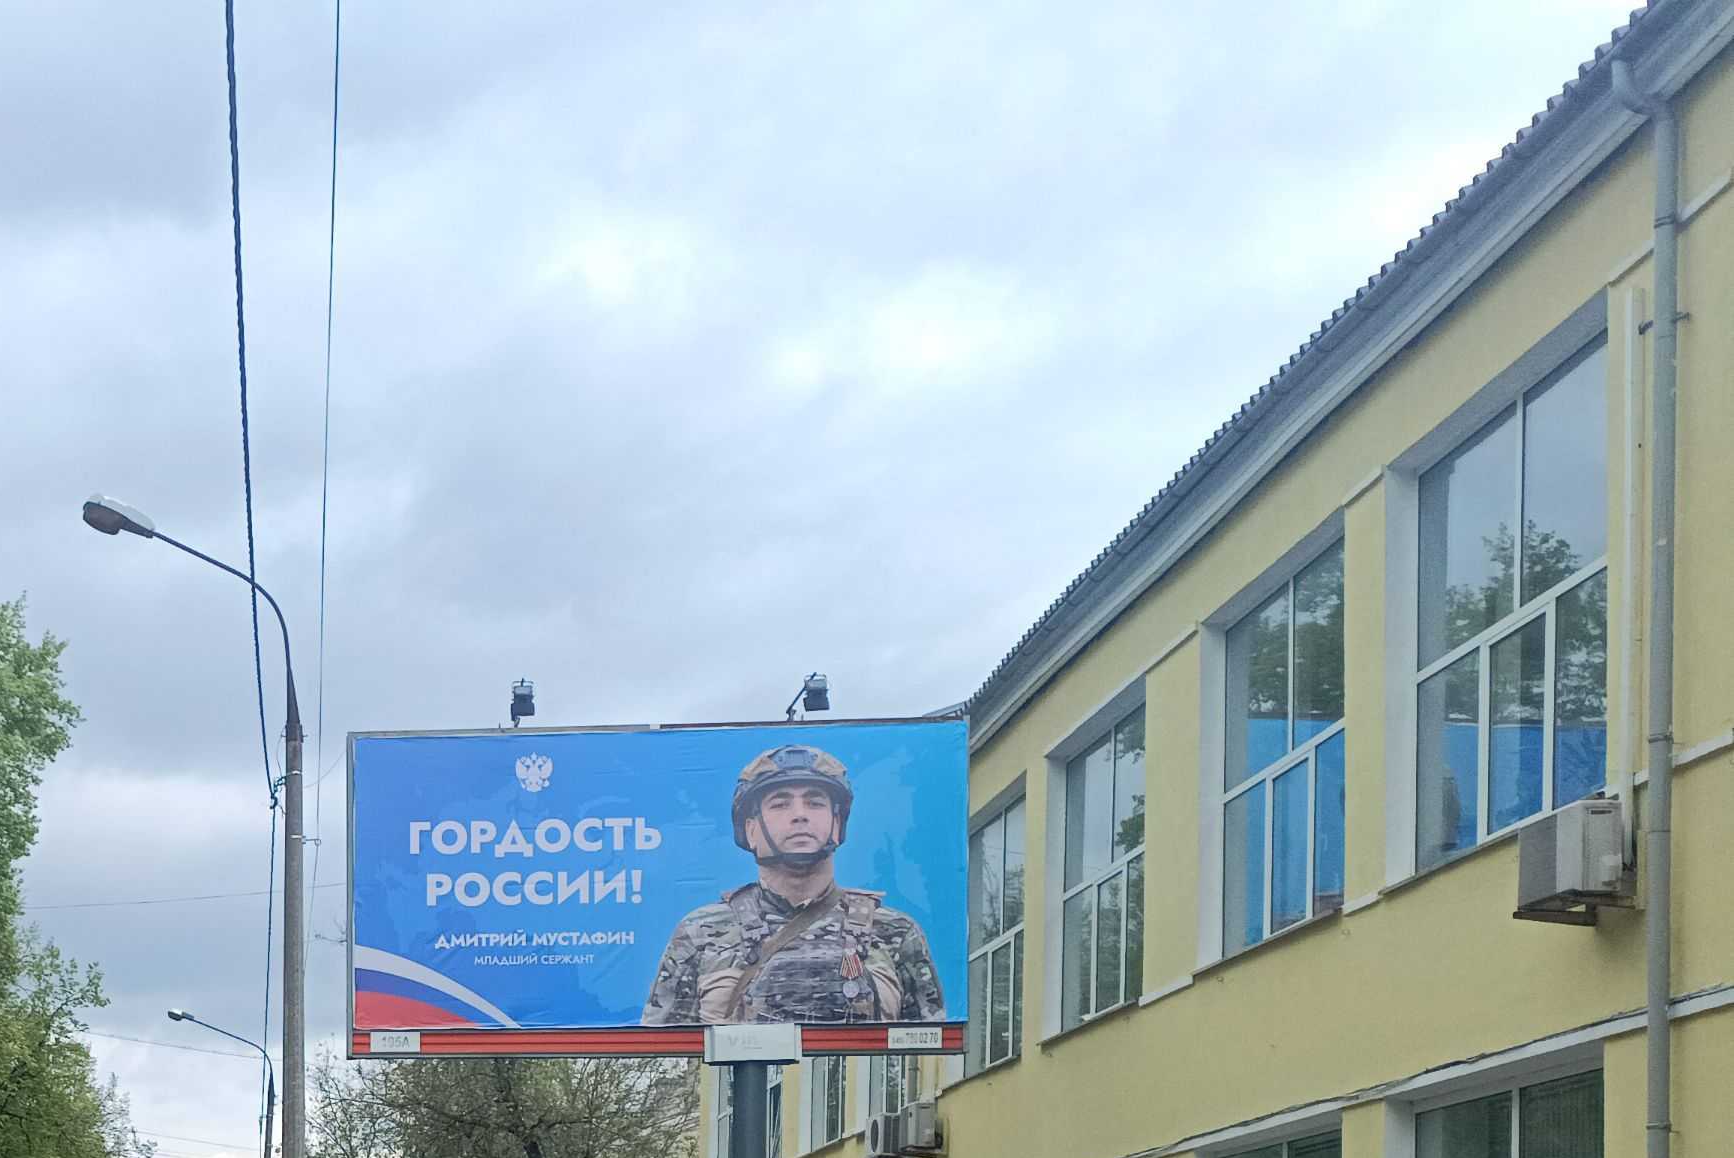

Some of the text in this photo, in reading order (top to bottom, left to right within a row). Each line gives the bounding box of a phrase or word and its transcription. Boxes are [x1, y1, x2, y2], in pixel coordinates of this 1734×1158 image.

[409, 816, 662, 858] ГОРДОСТЬ
[426, 869, 643, 907] РОССИИ!
[434, 929, 635, 949] ДМИТРИЙ МУСТАФИН
[474, 953, 595, 967] МЛАДШИЙ СЕРЖАНТ
